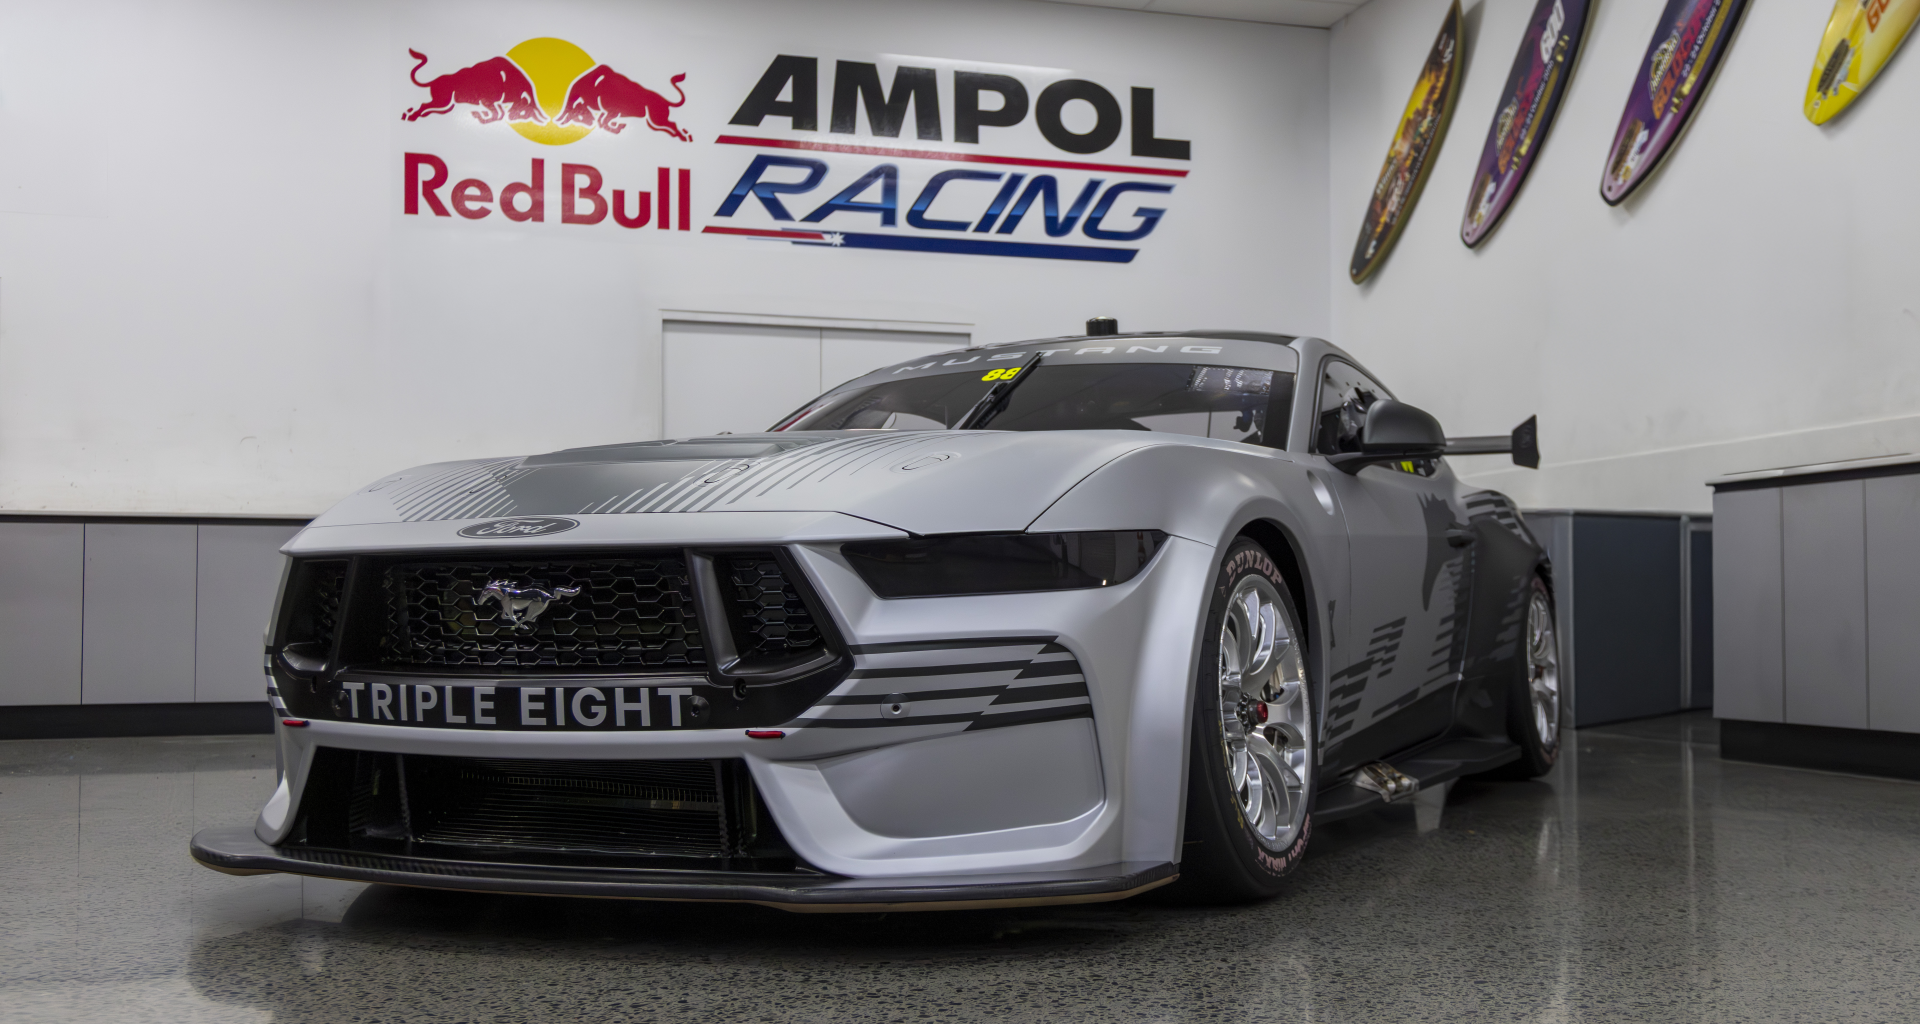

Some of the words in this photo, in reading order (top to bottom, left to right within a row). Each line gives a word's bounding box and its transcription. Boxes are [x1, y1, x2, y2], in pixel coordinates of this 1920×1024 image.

[727, 54, 1191, 160] AMPOL
[404, 152, 544, 222] Red
[561, 163, 690, 232] Bull
[713, 154, 1177, 241] RACING
[892, 345, 1223, 375] MUSTANG
[476, 519, 557, 535] Ford
[1226, 550, 1282, 587] DUNLOP
[342, 681, 497, 725] TRIPLE
[520, 687, 693, 727] EIGHT
